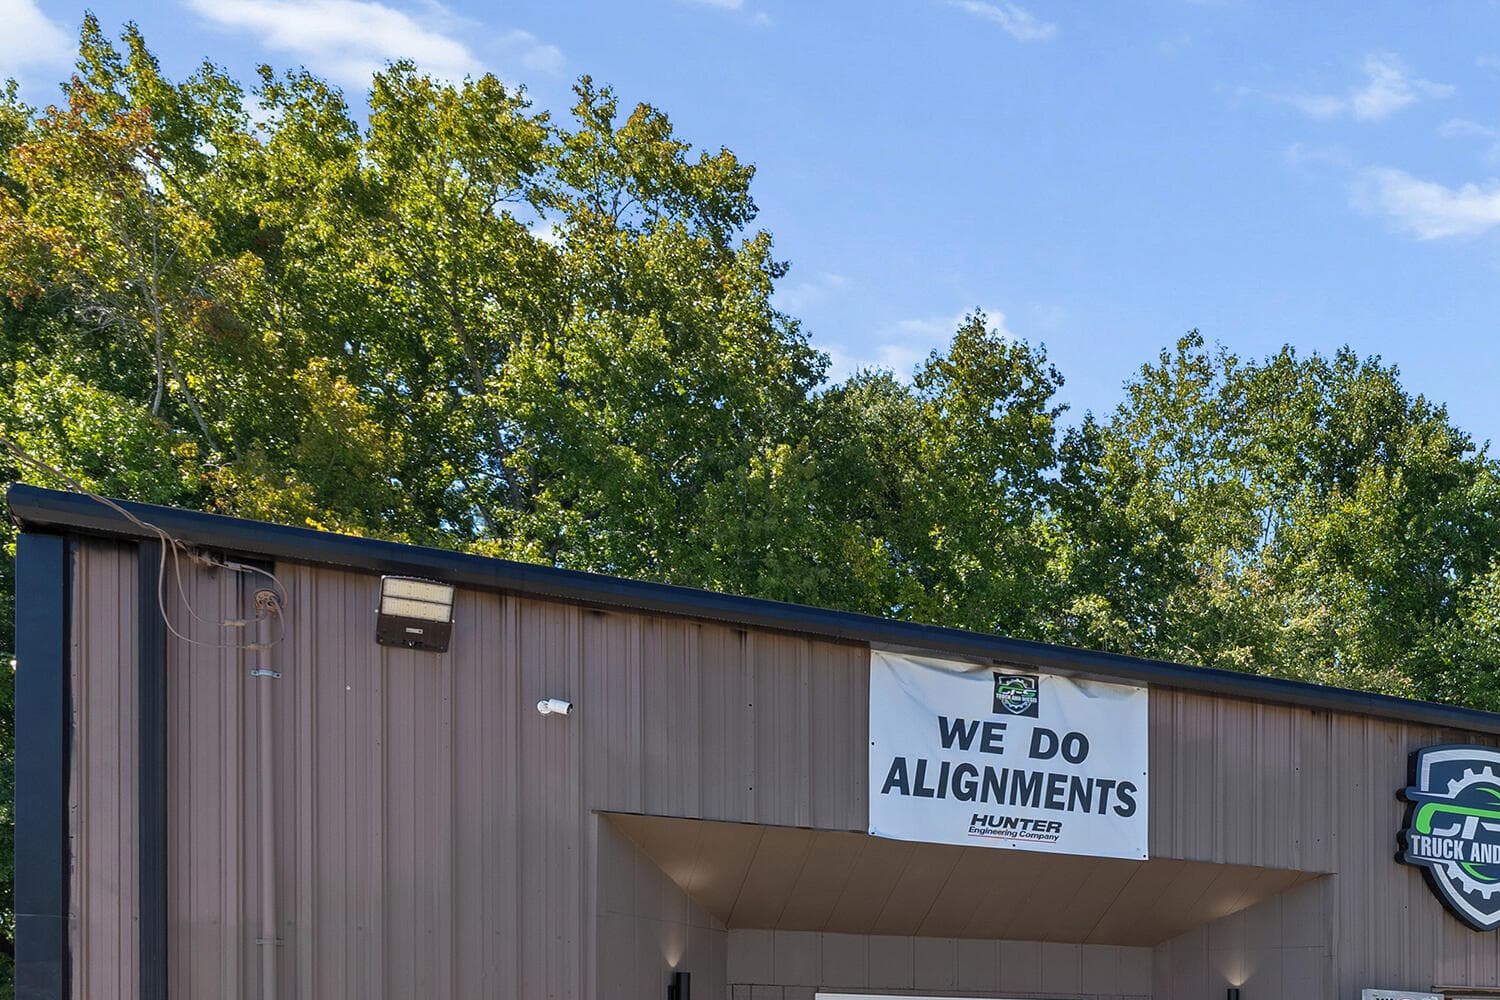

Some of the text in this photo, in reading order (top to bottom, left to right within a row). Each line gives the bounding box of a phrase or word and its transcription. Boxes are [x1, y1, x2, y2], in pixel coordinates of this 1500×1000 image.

[938, 716, 1090, 765] WE DO
[880, 756, 1138, 818] ALIGNMENTS
[968, 826, 1060, 842] Engineering Company
[970, 813, 1063, 834] HUNTER
[1410, 834, 1465, 861] TRUCK
